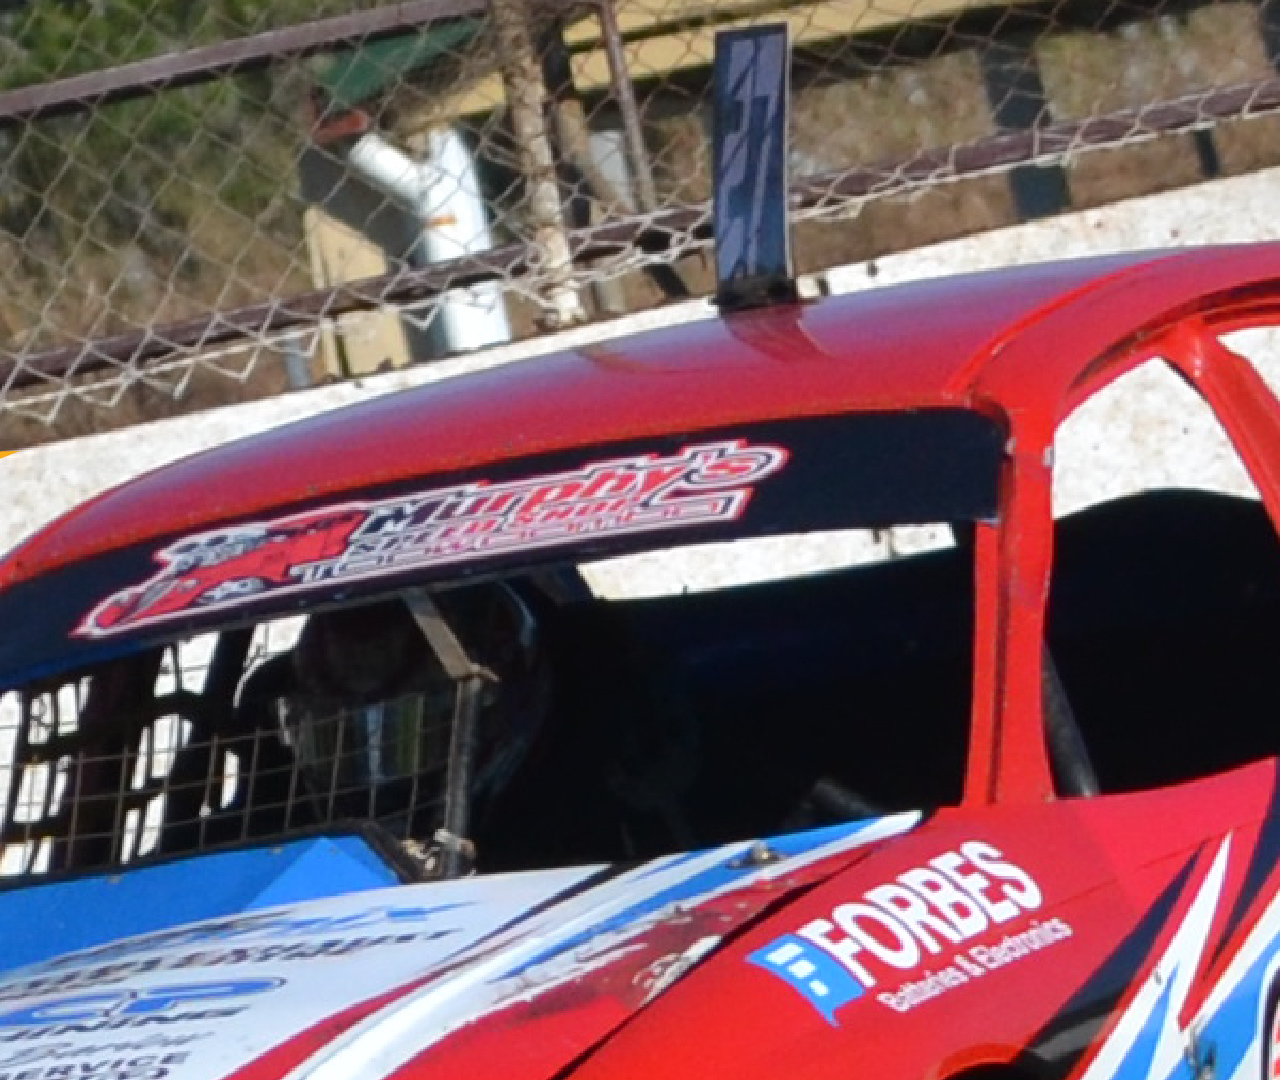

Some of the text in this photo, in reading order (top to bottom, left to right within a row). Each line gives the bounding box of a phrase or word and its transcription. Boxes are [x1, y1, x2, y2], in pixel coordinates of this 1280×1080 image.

[797, 840, 1044, 989] FORBES
[876, 917, 1074, 1013] Batteries & Electronics
